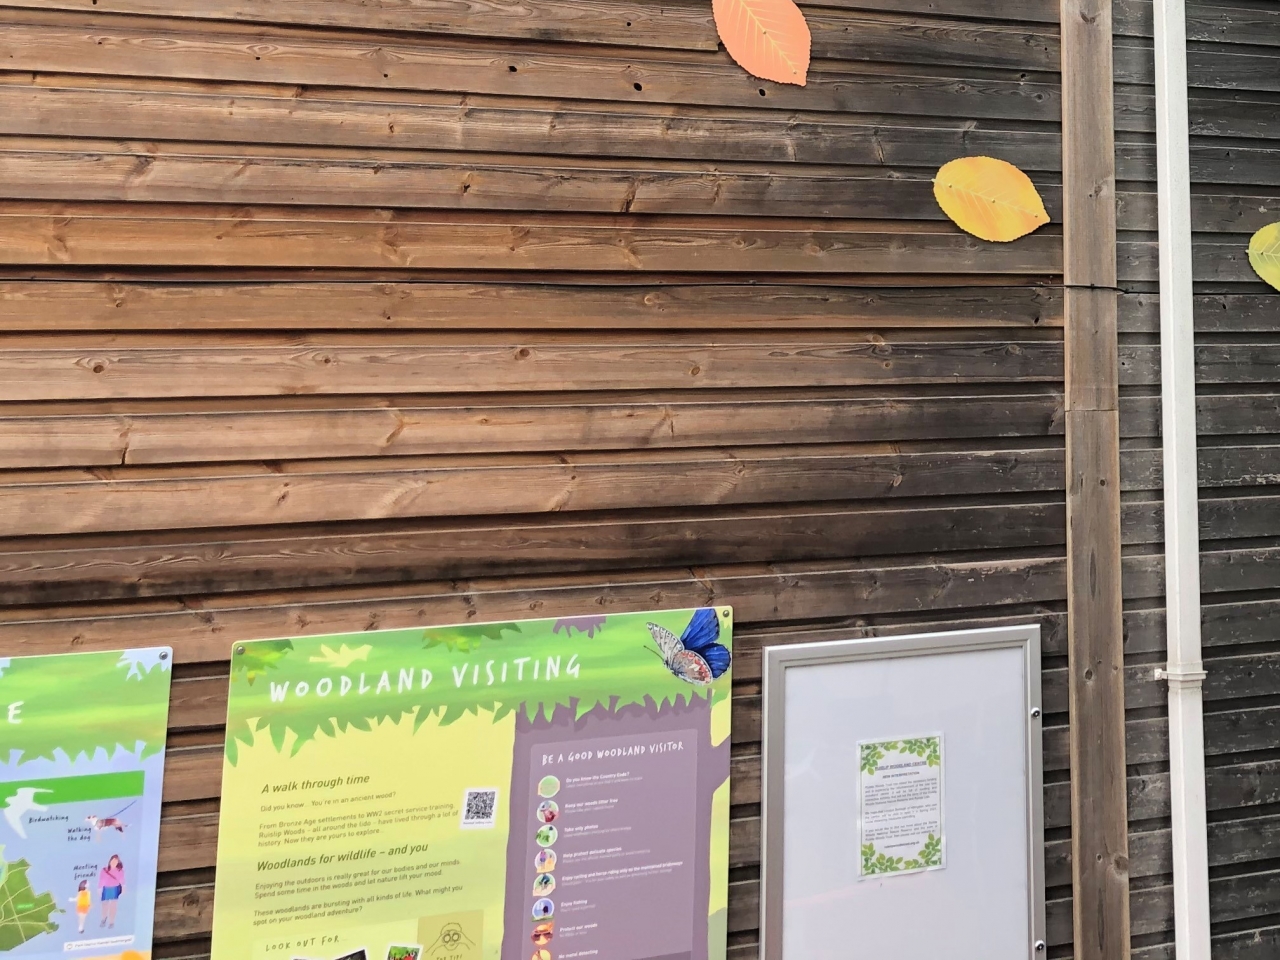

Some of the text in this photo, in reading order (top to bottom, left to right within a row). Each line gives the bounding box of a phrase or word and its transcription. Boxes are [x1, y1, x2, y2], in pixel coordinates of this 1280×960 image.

[270, 653, 580, 703] WOODLAND VISITING
[542, 741, 684, 766] BE A GOOD WOODLAND VISITOR
[261, 775, 370, 794] A walk through time
[350, 794, 374, 802] ancient
[376, 791, 396, 799] wood?
[284, 828, 305, 836] Woods
[323, 823, 345, 831] around
[411, 813, 436, 821] through
[318, 814, 356, 823] settlements
[366, 810, 382, 818] WW2
[329, 832, 346, 840] yours
[257, 856, 316, 871] Woodlands
[319, 854, 335, 864] for
[337, 848, 376, 861] wildlife
[388, 844, 408, 856] and
[410, 844, 428, 855] you
[256, 881, 283, 890] Enjoying
[297, 876, 325, 885] outdoors
[394, 865, 414, 873] bodies
[255, 891, 275, 899] Spend
[275, 905, 310, 914] woodlands
[324, 899, 350, 908] bursting
[376, 893, 393, 901] kinds
[433, 886, 450, 894] might
[253, 918, 267, 926] spot
[295, 911, 325, 920] woodland
[327, 906, 362, 916] adventure?
[266, 942, 290, 952] LOOK
[297, 937, 316, 947] OUT
